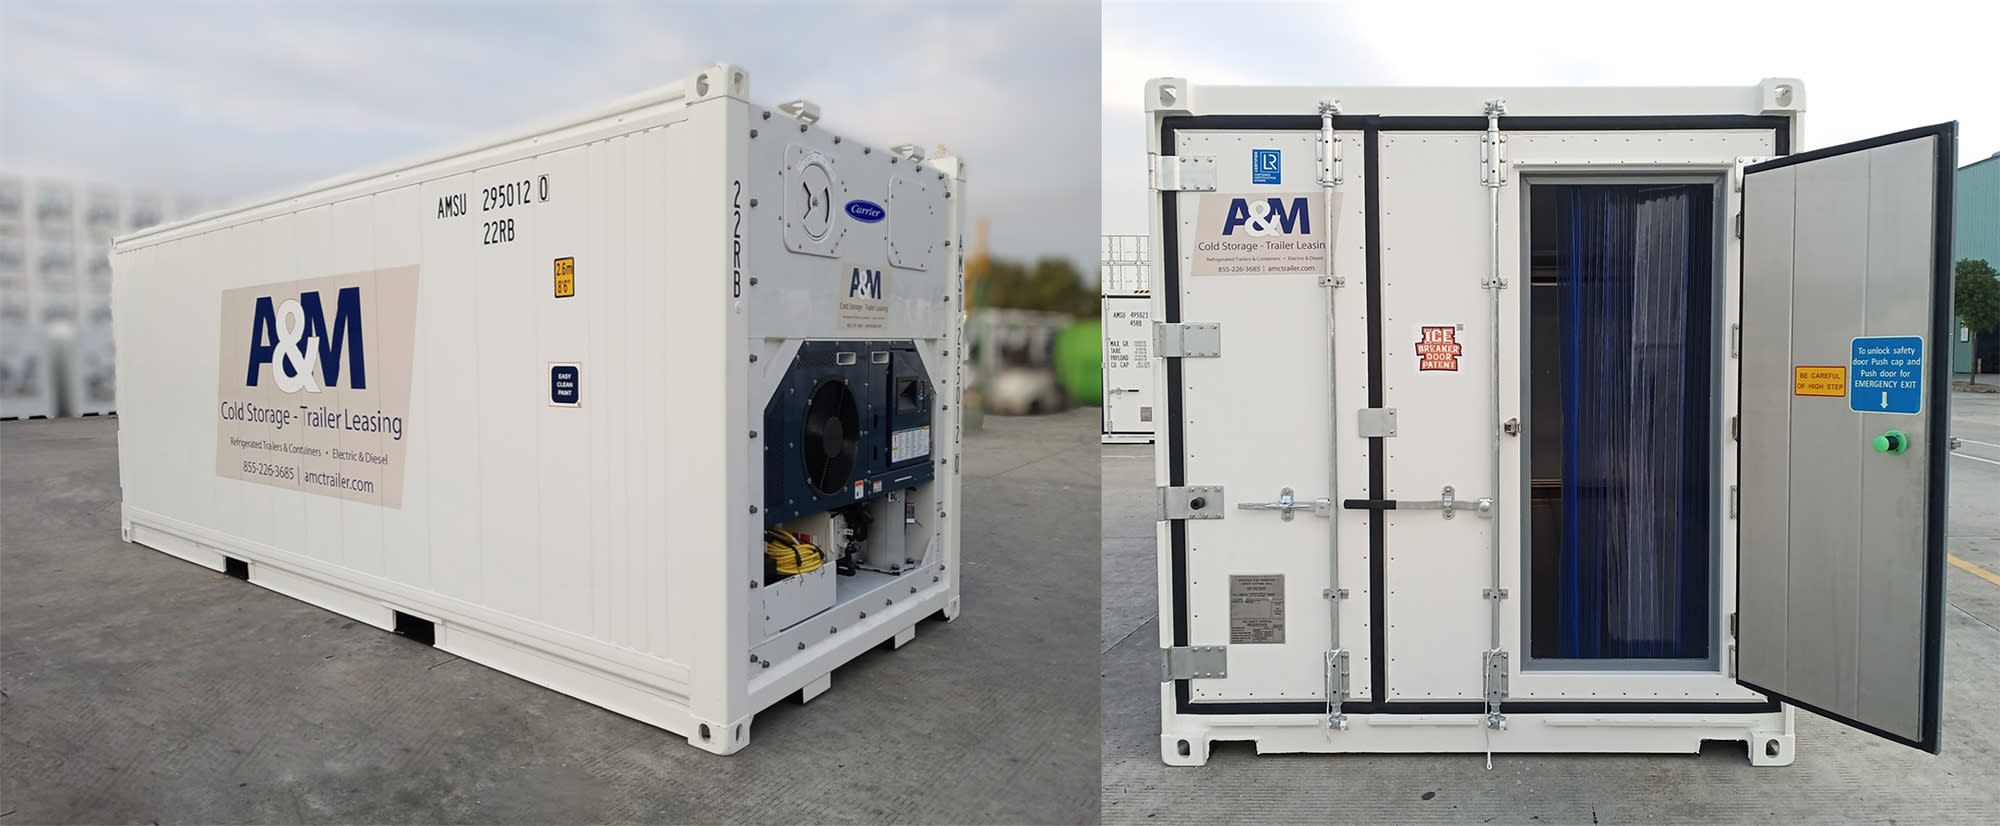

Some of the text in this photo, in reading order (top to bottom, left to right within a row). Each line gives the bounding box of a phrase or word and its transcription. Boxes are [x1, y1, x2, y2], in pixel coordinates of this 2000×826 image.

[1263, 154, 1278, 170] LR
[437, 176, 548, 219] AMSU 295012 0
[850, 203, 881, 217] Carrier
[1222, 197, 1311, 237] A&M
[483, 218, 515, 245] 22RB
[733, 180, 742, 298] 22RB
[1198, 241, 1220, 251] Cold
[1222, 242, 1258, 252] Storage
[1265, 240, 1294, 250] Trailer
[1296, 241, 1326, 250] Leasin
[849, 267, 881, 300] A&M
[246, 286, 367, 394] A&M
[1423, 329, 1454, 344] ICE
[1418, 345, 1459, 353] BREAKER
[1858, 346, 1915, 355] To unlock safety
[1426, 353, 1452, 361] DOOR
[1852, 358, 1921, 368] door Push cap and
[1422, 361, 1456, 369] PATENT
[1810, 372, 1841, 380] CAREFUL
[1880, 370, 1897, 378] door
[1900, 369, 1911, 378] for
[1854, 380, 1917, 389] EMERGENCY EXIT
[221, 401, 245, 421] Cold
[247, 402, 290, 429] Storage
[300, 405, 341, 429] Trailer
[344, 408, 402, 440] Leasing
[230, 437, 263, 450] Refrigerated
[262, 440, 284, 452] Trailers
[288, 443, 322, 456] Containers
[332, 449, 357, 462] Electric
[365, 452, 388, 465] Diesel
[242, 460, 295, 480] 855-226-3685
[304, 471, 374, 493] amctrailer.com
